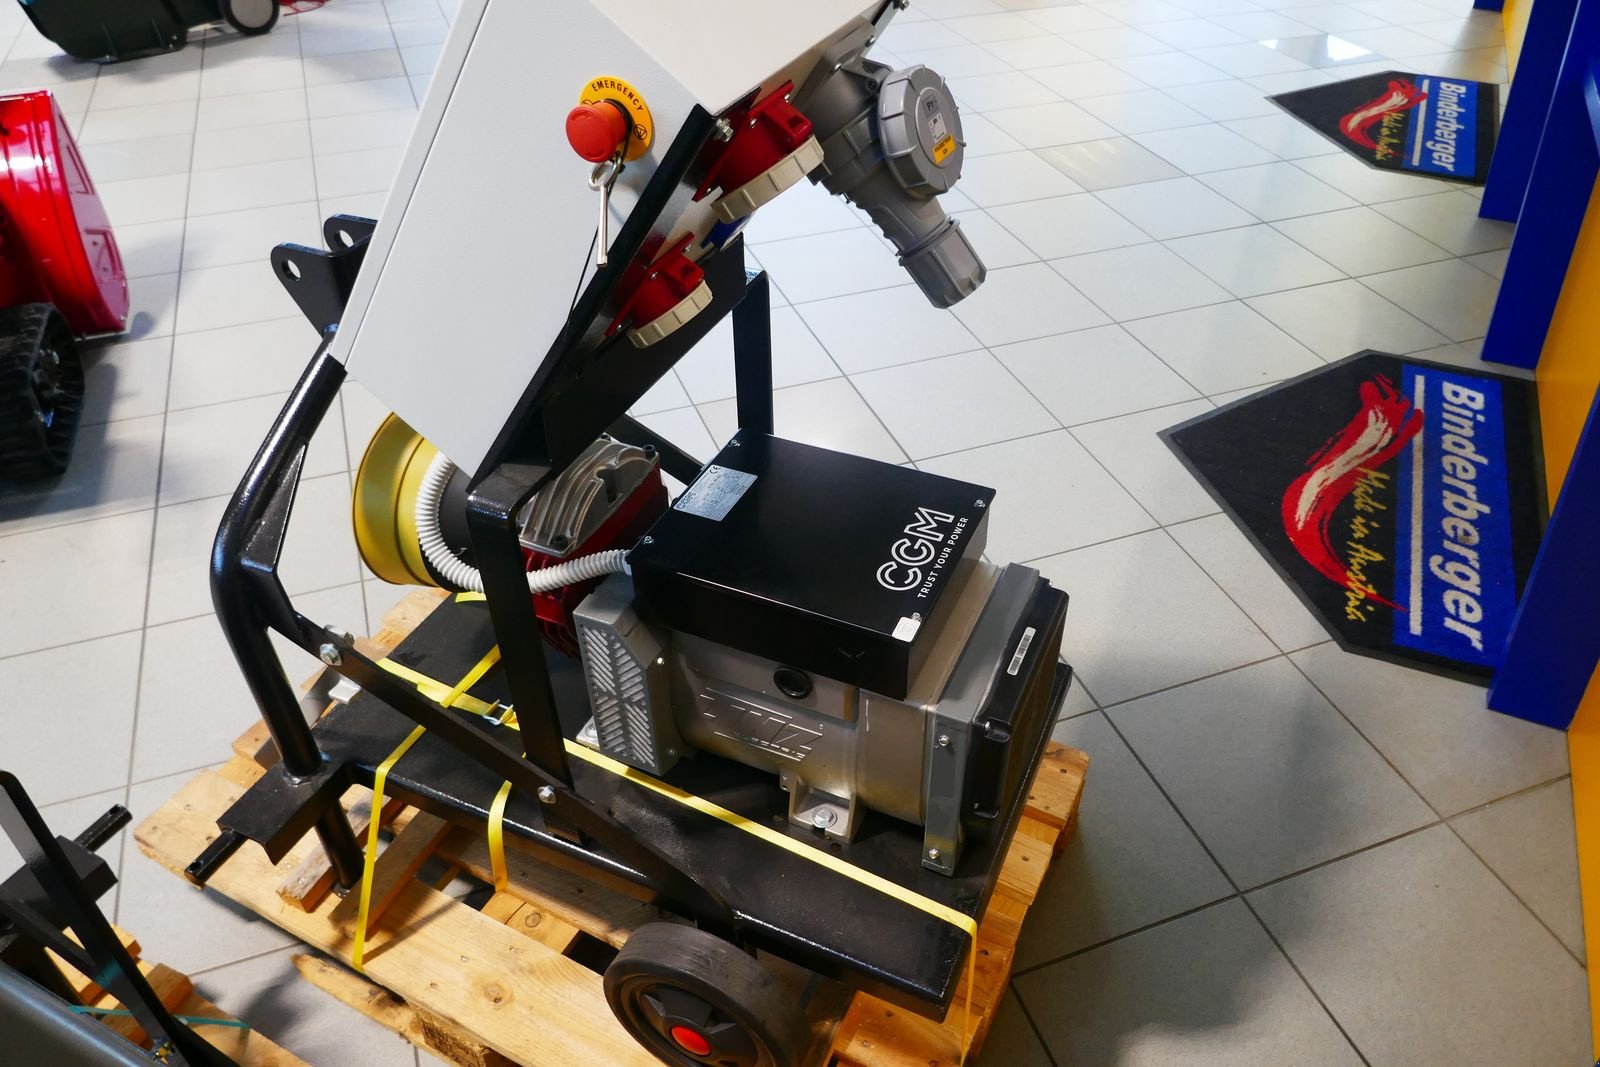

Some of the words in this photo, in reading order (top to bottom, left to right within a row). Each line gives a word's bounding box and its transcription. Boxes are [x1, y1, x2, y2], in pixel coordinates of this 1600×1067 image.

[592, 80, 644, 111] EMERGENCY
[1425, 82, 1467, 171] Binderberger
[1350, 515, 1381, 539] in
[1353, 466, 1391, 513] Made
[1429, 381, 1491, 651] Binderberger
[876, 507, 955, 591] CGM
[917, 571, 939, 598] TRUST
[934, 547, 952, 569] YOUR
[948, 517, 968, 545] POWER
[1345, 541, 1386, 622] Austria
